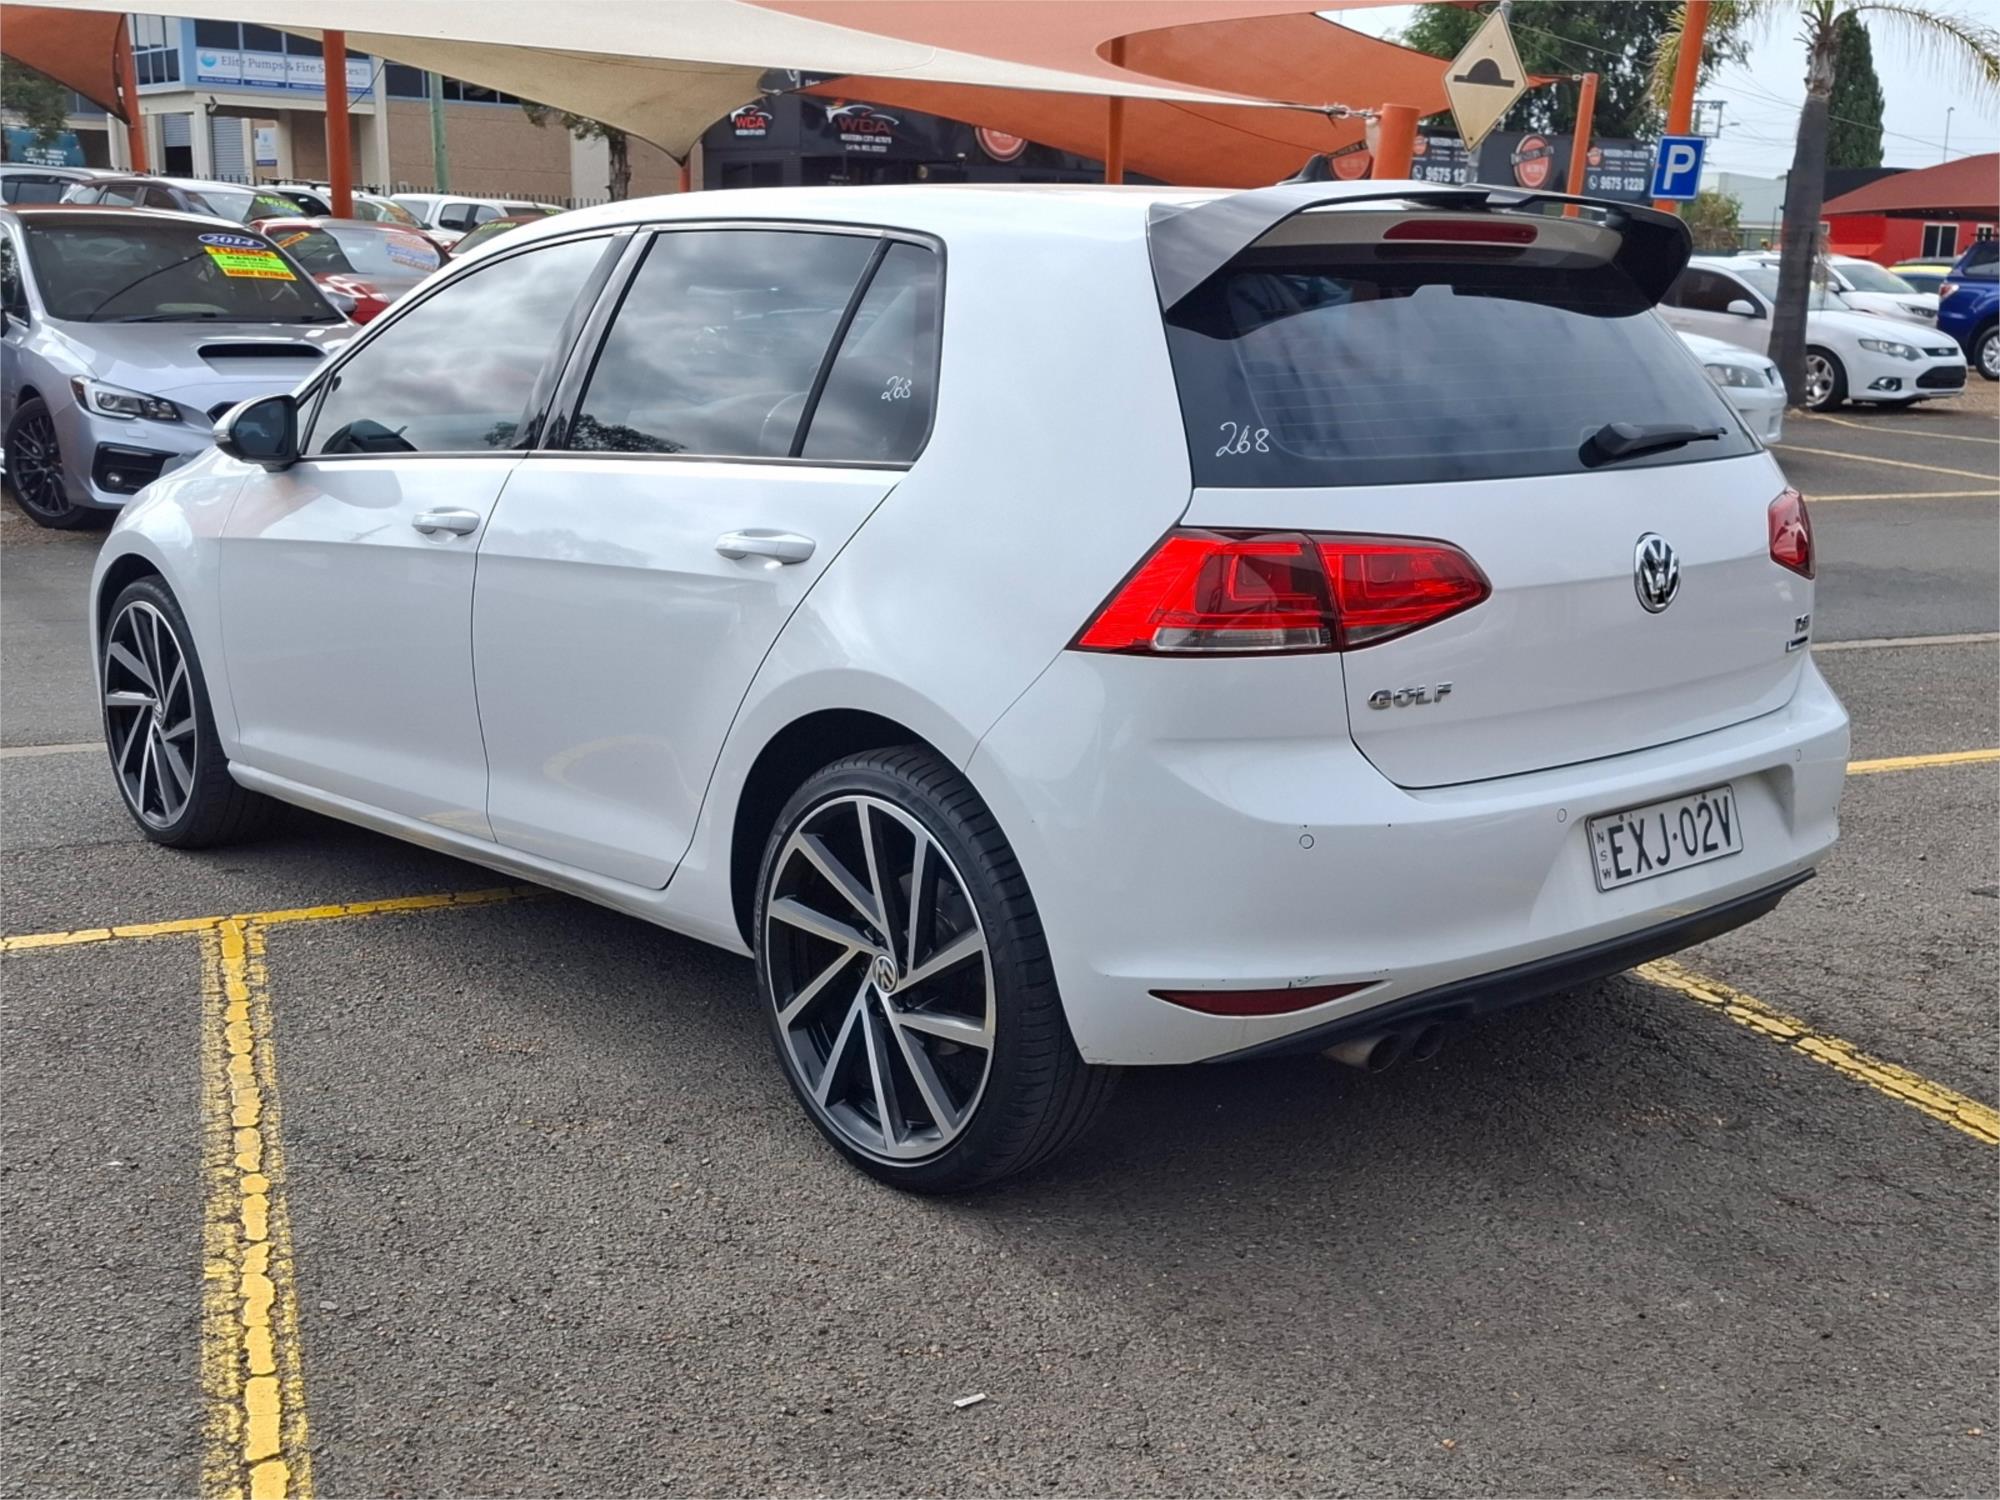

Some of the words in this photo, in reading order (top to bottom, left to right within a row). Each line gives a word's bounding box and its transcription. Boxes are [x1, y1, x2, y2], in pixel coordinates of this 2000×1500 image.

[248, 58, 284, 71] Pumps
[296, 62, 316, 73] Fire
[1663, 144, 1696, 191] P
[206, 234, 254, 246] 2014
[881, 375, 912, 402] 268
[1215, 421, 1270, 457] 268
[1367, 681, 1453, 711] GOLF
